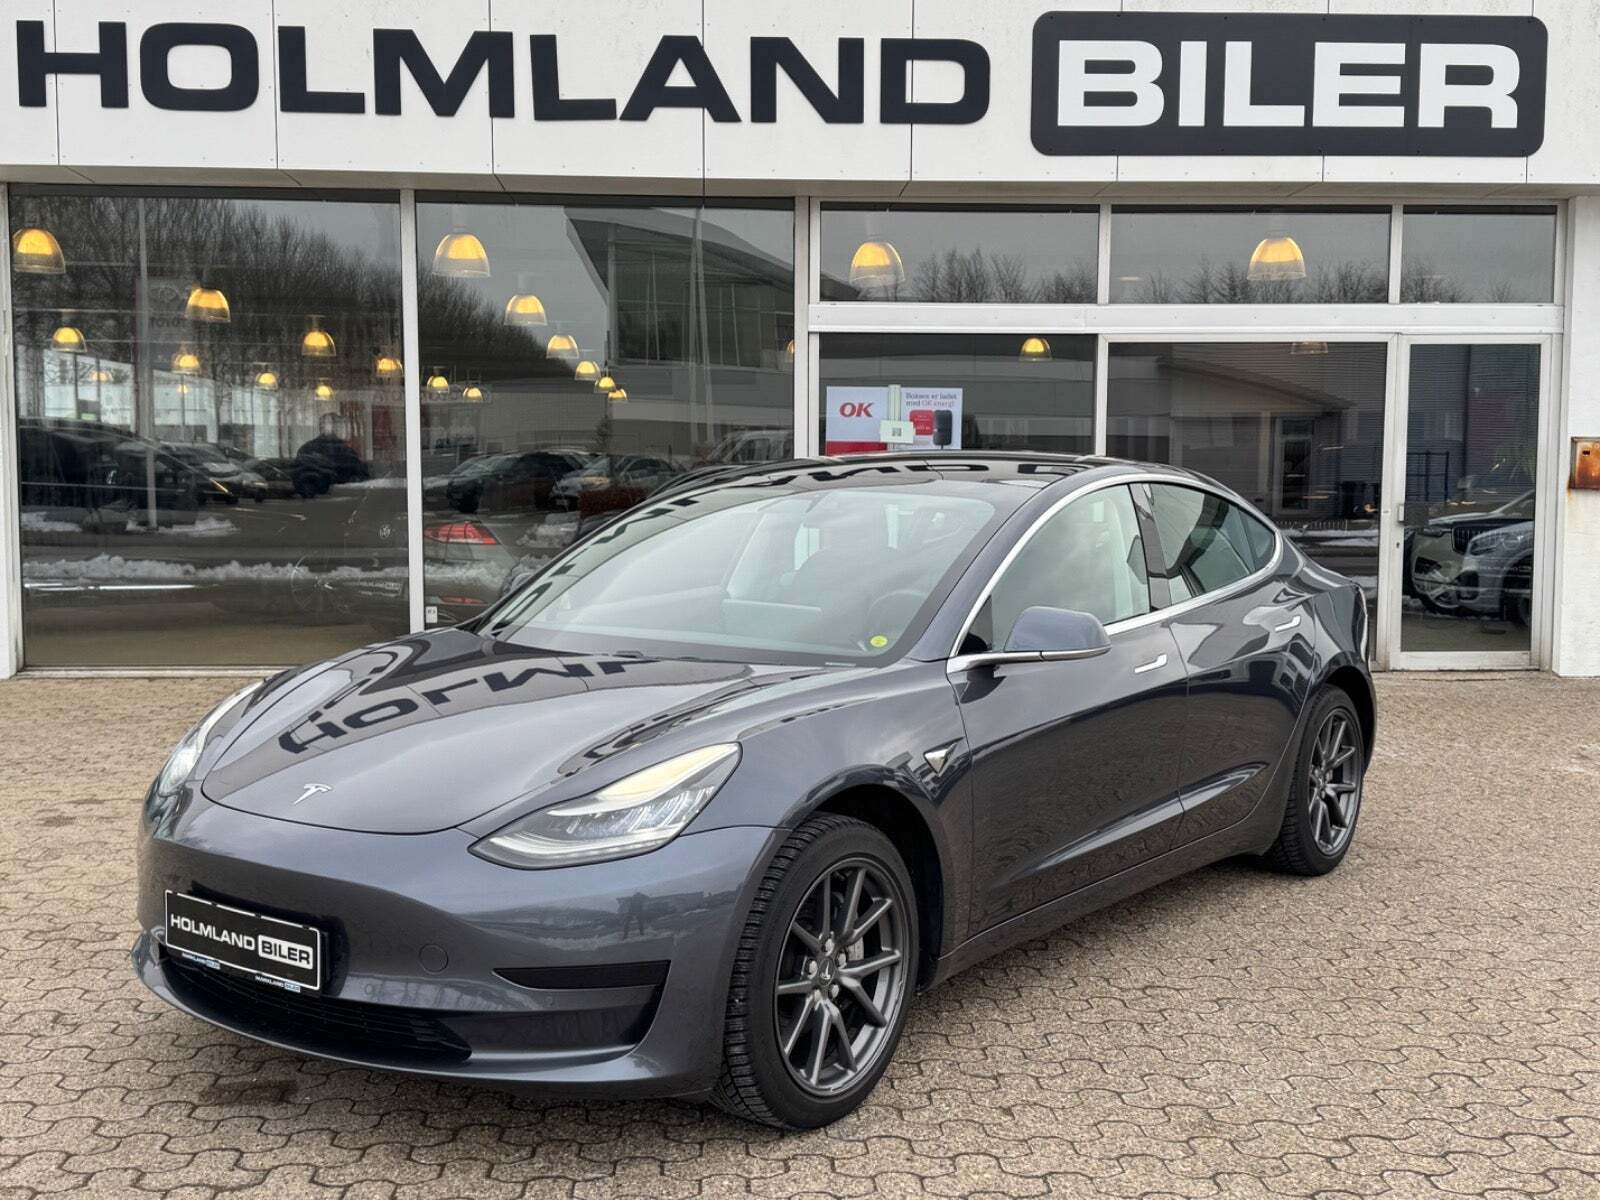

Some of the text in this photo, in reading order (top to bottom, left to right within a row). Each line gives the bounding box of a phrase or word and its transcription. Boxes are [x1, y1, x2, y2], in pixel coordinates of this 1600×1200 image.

[16, 19, 1521, 129] HOLMLAND BILER
[839, 402, 874, 418] OK
[170, 913, 311, 965] HOLMLAND BILER
